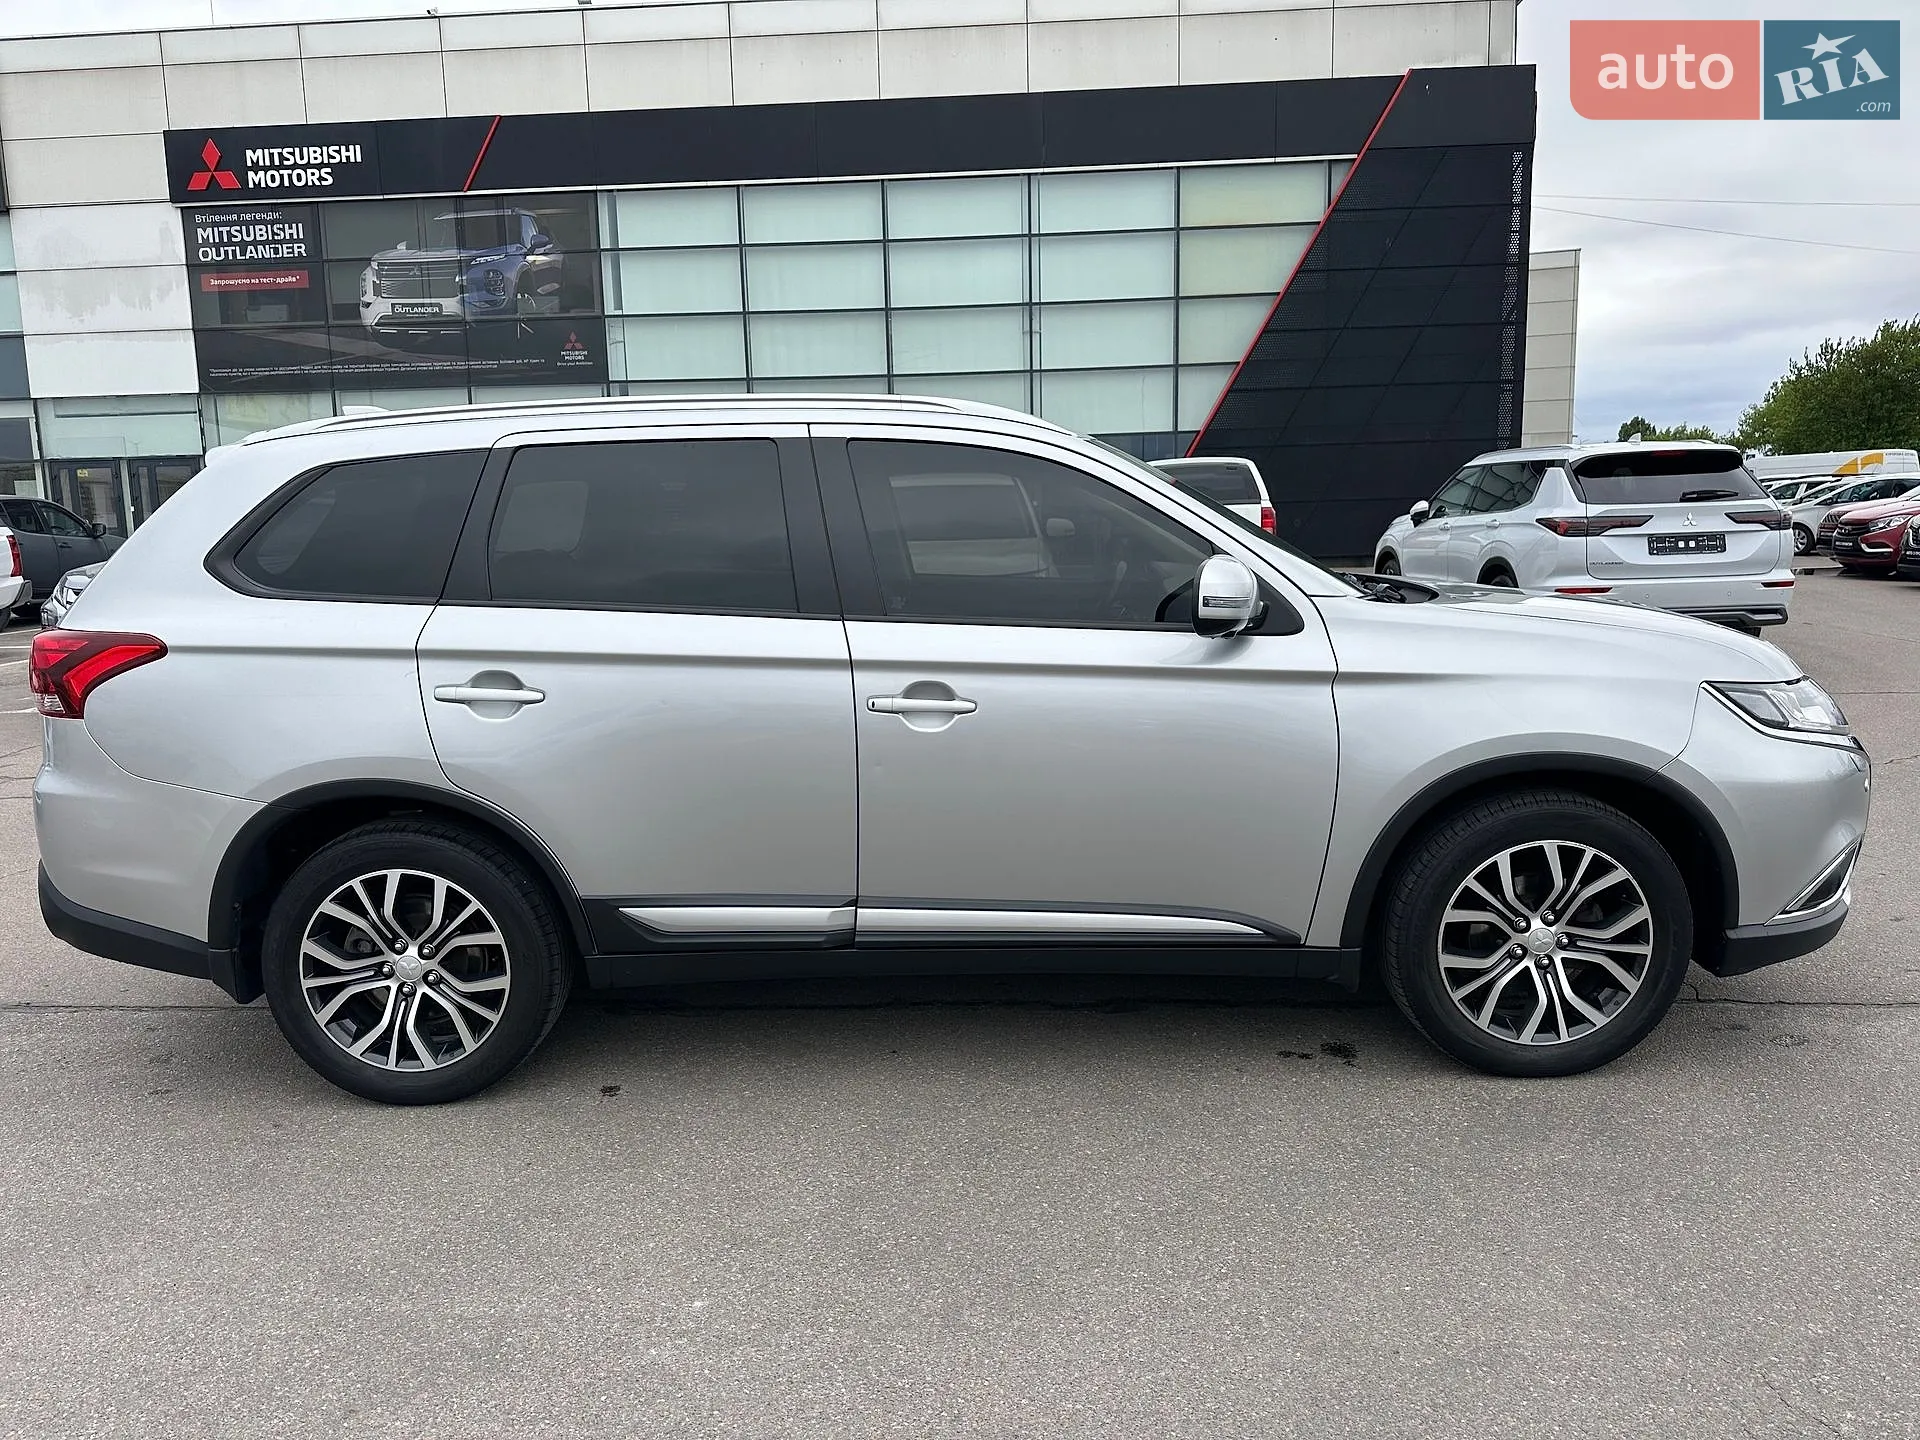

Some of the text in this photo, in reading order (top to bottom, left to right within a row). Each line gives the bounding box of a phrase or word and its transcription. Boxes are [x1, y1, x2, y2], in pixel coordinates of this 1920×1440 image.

[245, 144, 362, 167] MITSUBISHI
[247, 167, 334, 188] MOTORS
[195, 211, 282, 223] Втілення легенди:
[196, 223, 304, 244] MITSUBISHI
[198, 243, 307, 262] OUTLANDER
